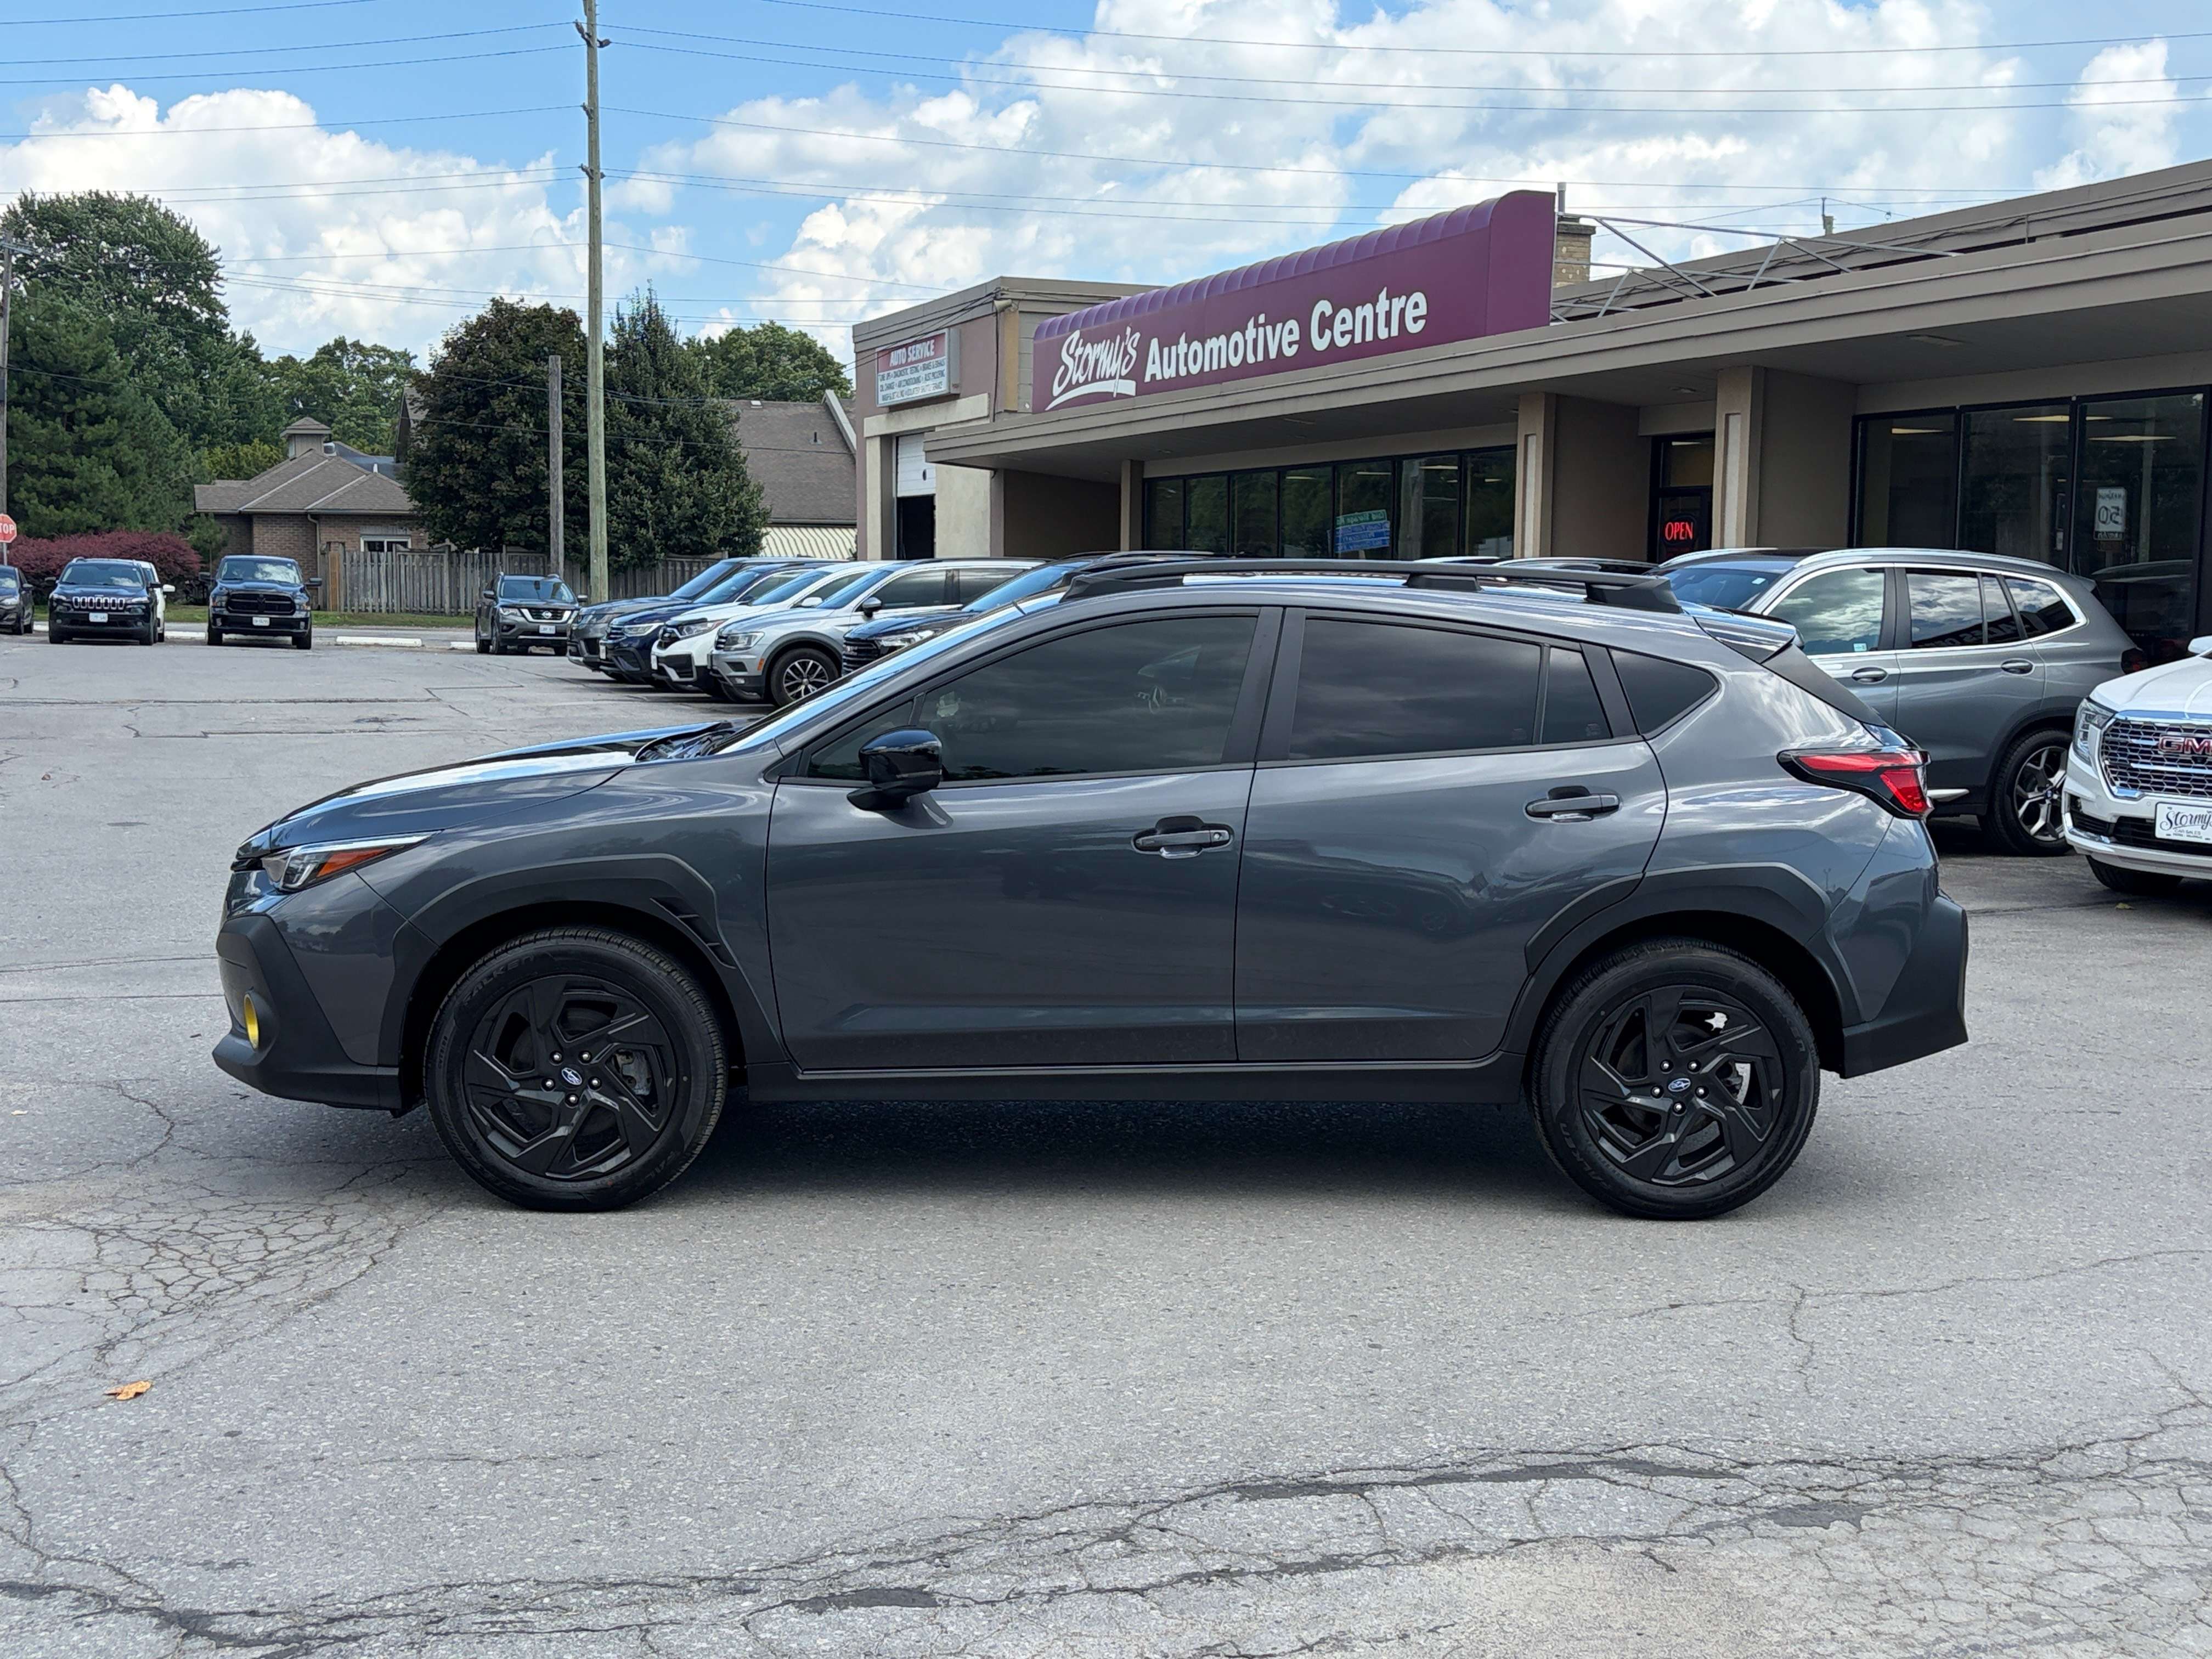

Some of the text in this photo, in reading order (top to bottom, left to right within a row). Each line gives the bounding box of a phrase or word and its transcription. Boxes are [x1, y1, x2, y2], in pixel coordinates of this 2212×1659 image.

[1053, 286, 1427, 398] Stormy's Automotive Centre
[889, 339, 935, 367] AUTO SERVICE
[0, 523, 15, 534] TOP
[1665, 522, 1694, 541] OPEN
[2159, 736, 2212, 755] GM
[2160, 811, 2212, 831] Stormy
